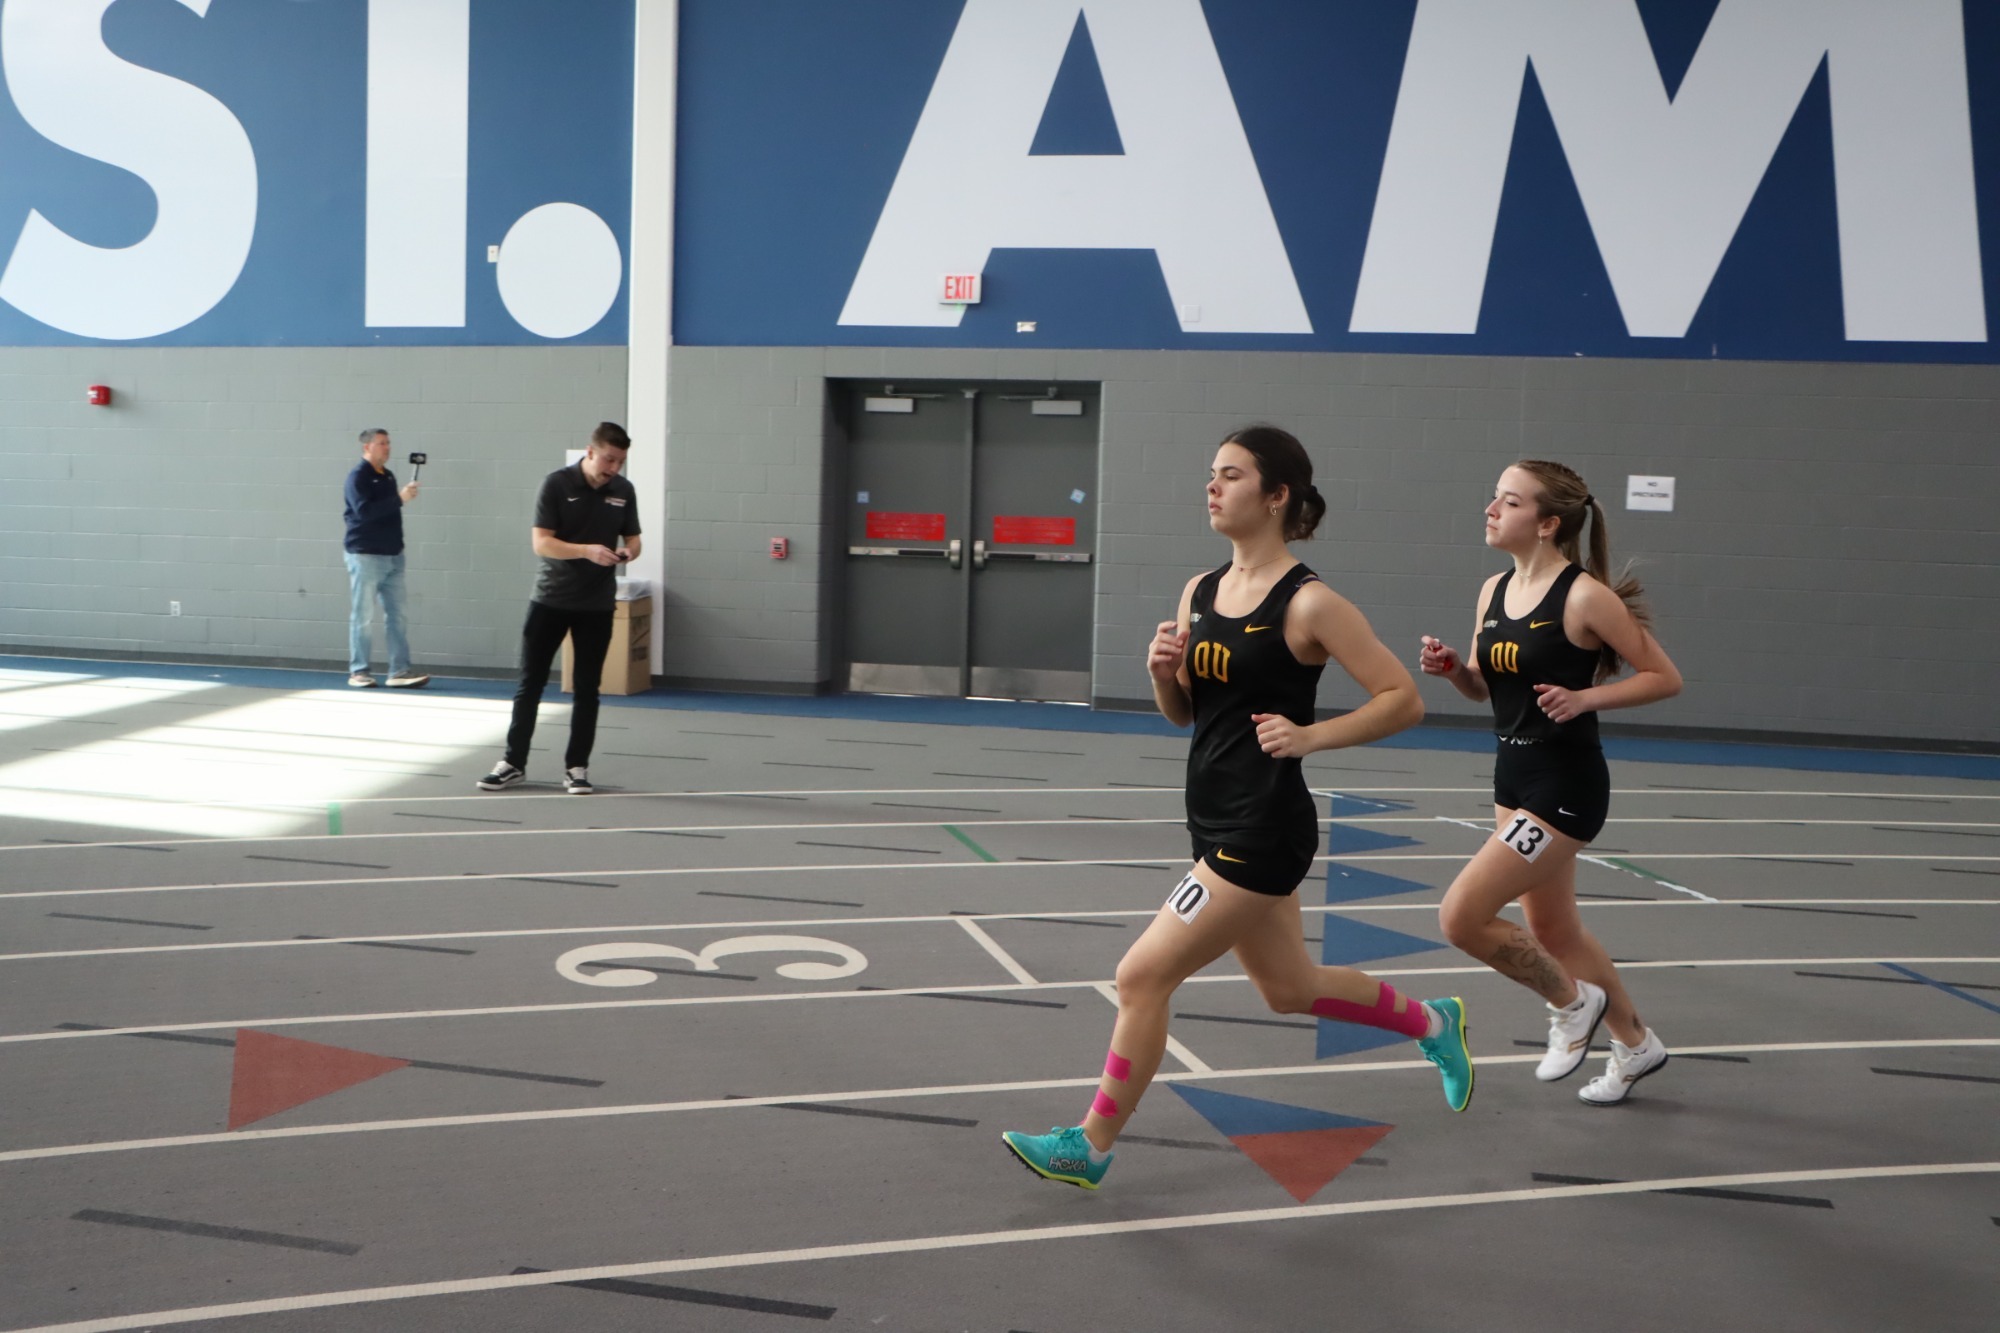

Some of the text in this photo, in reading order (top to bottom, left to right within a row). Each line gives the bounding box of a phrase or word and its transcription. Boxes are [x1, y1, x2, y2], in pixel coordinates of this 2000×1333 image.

[838, 0, 1988, 344] AM
[944, 275, 975, 300] EXIT
[1194, 640, 1231, 683] QU
[1504, 817, 1545, 856] 13
[1168, 875, 1204, 916] 10
[555, 934, 869, 987] 3
[1048, 1156, 1088, 1172] HOKA
